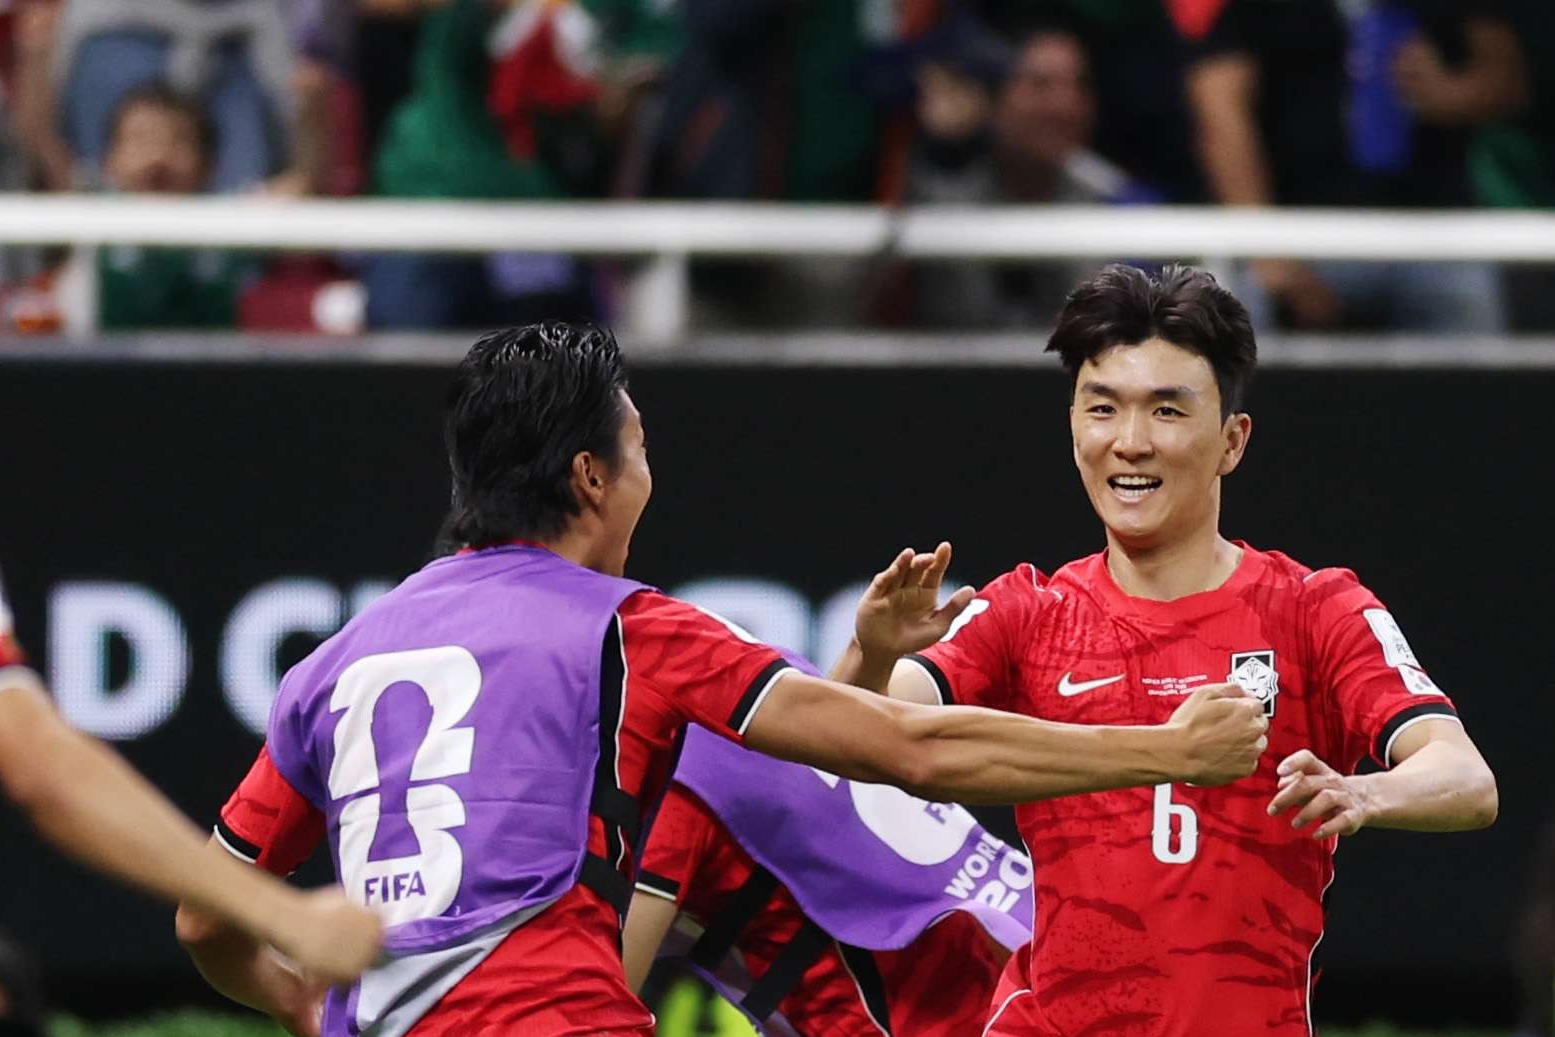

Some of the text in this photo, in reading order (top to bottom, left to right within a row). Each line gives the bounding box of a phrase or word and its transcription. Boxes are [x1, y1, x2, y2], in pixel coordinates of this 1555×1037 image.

[1150, 783, 1199, 864] 6
[364, 869, 427, 906] FIFA
[974, 849, 1033, 913] 20
